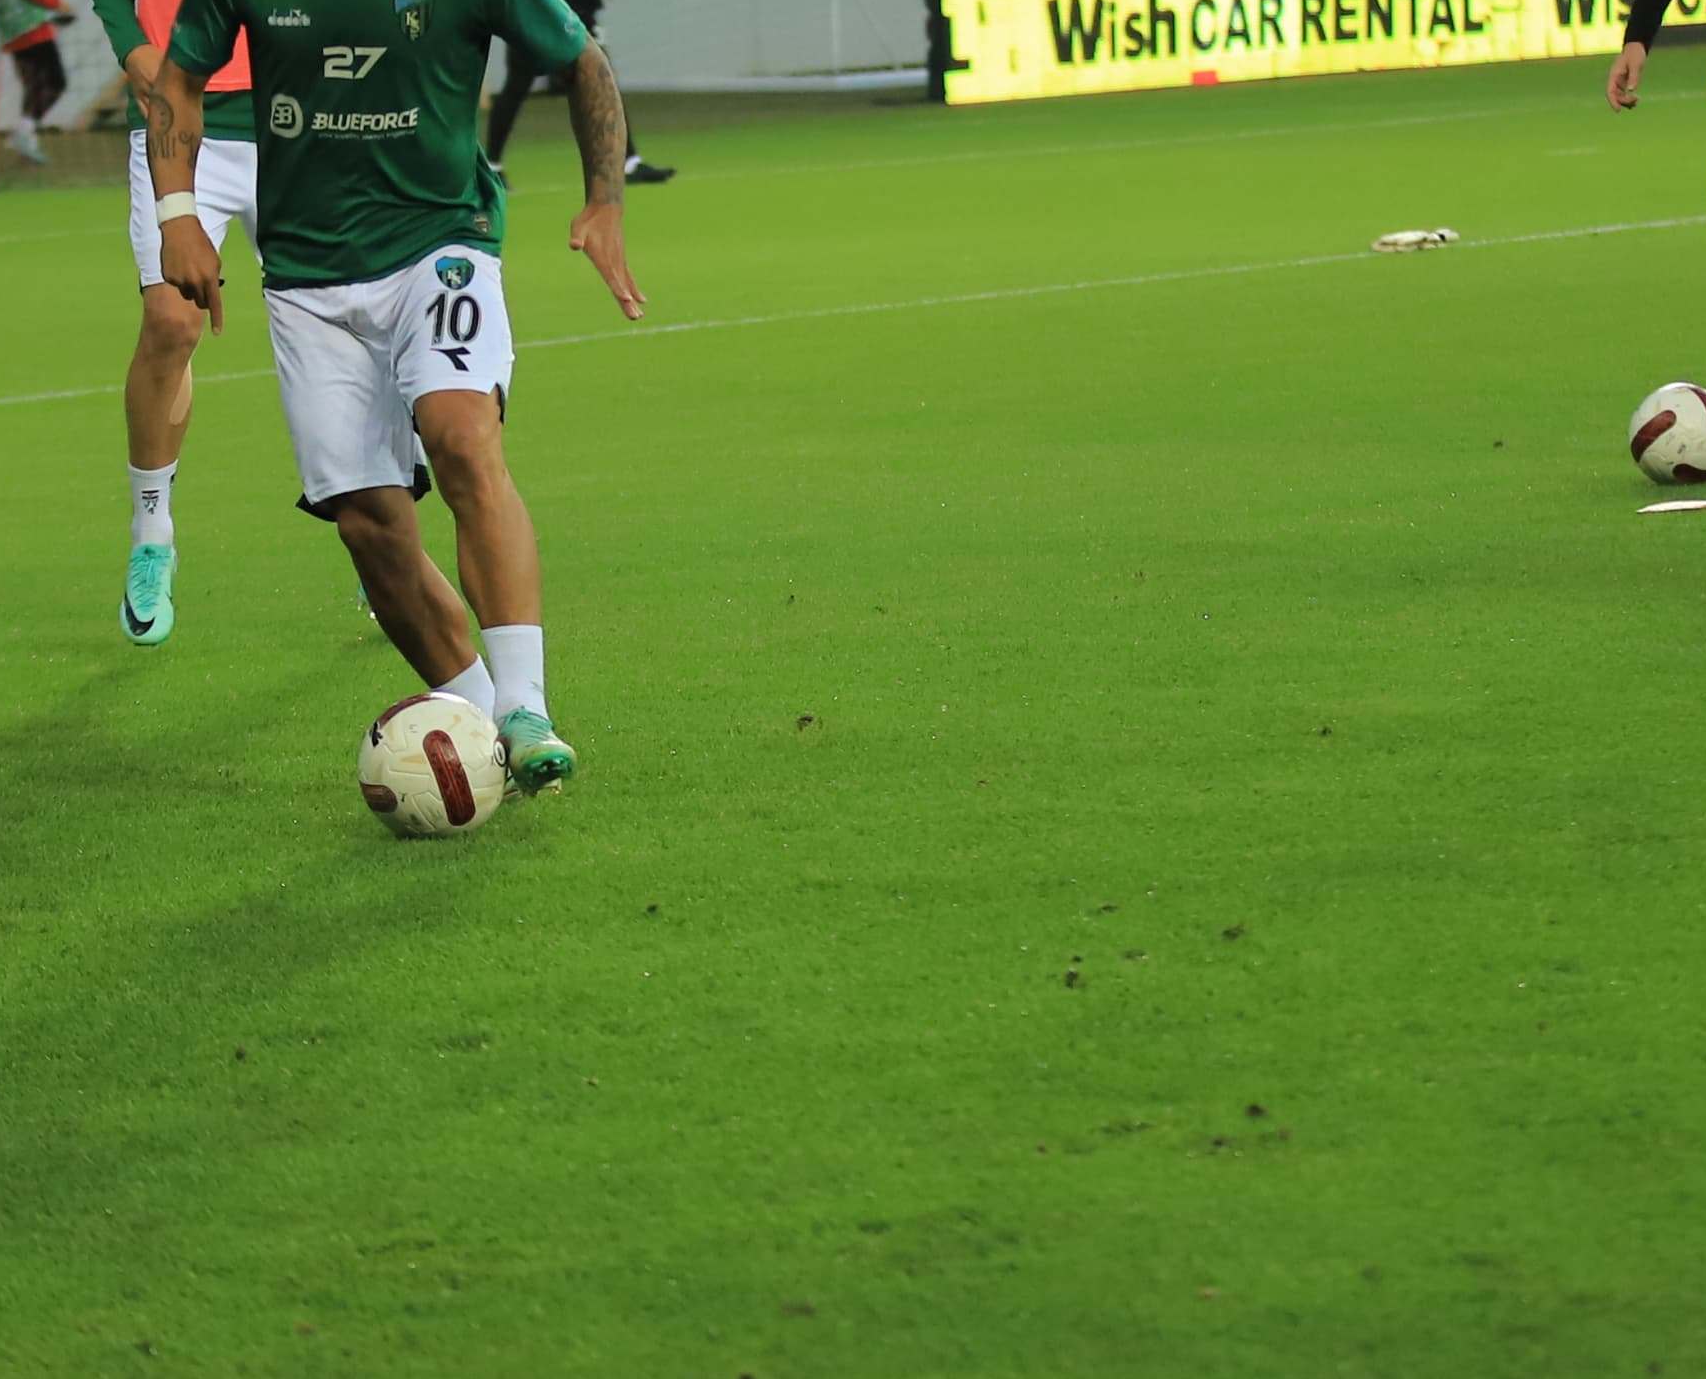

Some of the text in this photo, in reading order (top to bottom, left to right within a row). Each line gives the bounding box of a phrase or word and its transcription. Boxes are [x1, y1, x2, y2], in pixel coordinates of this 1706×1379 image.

[322, 46, 388, 79] 27
[311, 107, 420, 132] BLUEFORCE
[425, 291, 481, 344] 10
